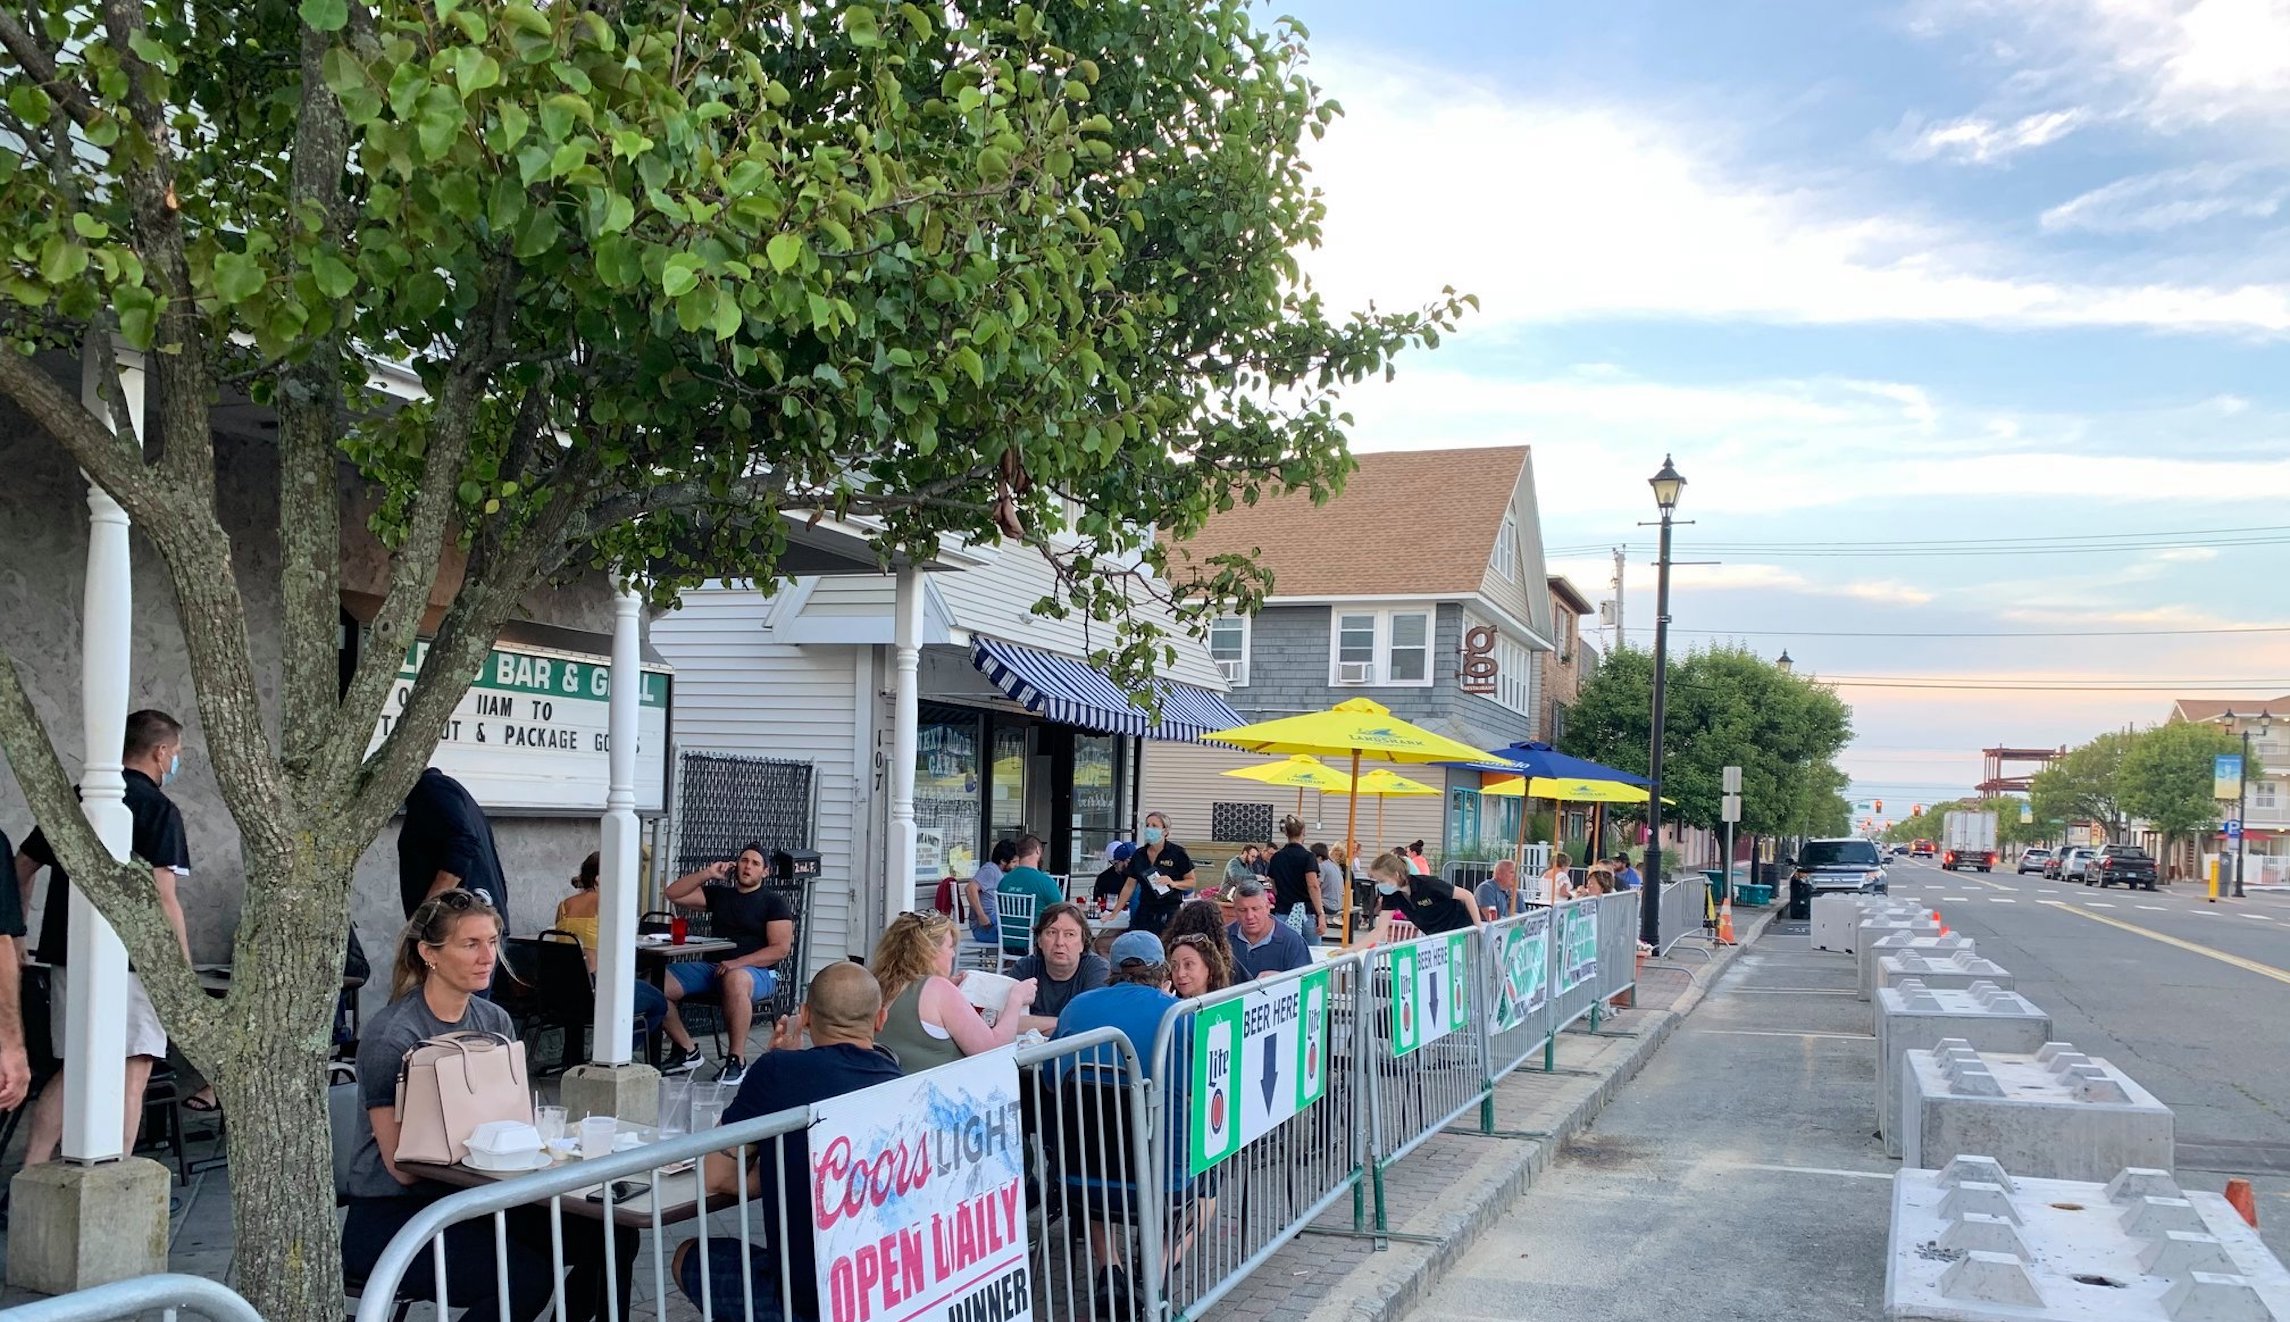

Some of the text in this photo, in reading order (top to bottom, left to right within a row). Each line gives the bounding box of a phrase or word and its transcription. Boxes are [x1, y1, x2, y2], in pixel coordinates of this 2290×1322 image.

[1464, 624, 1499, 678] g
[496, 653, 551, 690] BAR
[562, 663, 579, 693] &
[477, 693, 553, 721] 11AM TO
[476, 722, 486, 743] &
[505, 725, 577, 749] PACKAGE
[2227, 821, 2240, 835] P
[1418, 946, 1448, 971] BEER HERE
[1244, 992, 1299, 1039] BEER HERE
[1208, 1048, 1229, 1088] Lite
[812, 1100, 1021, 1231] Coors LIGHT
[829, 1176, 1019, 1322] OPEN DAILY
